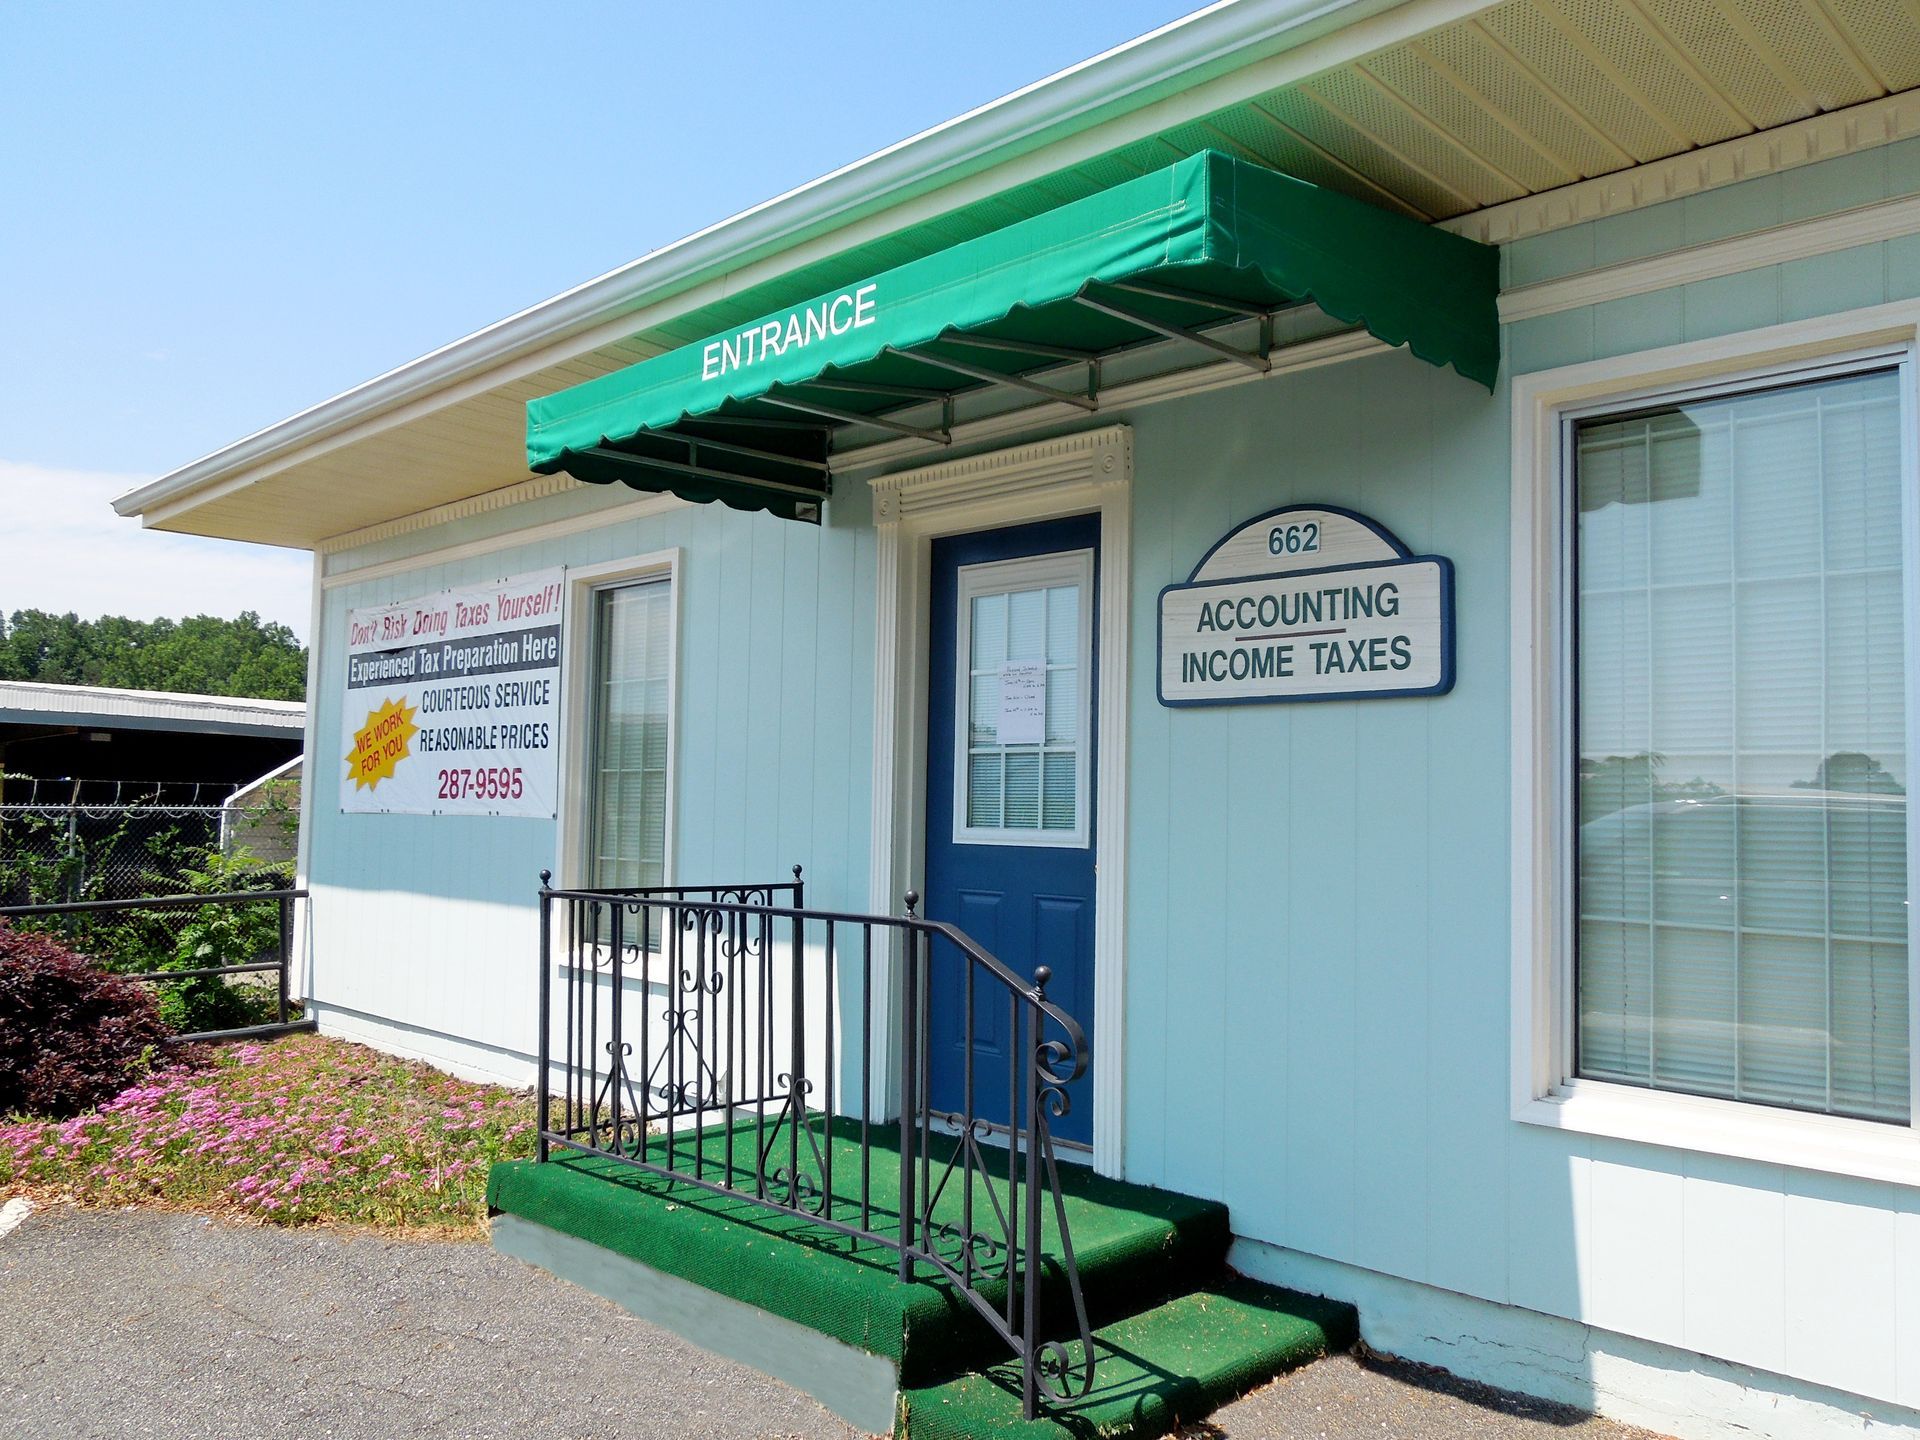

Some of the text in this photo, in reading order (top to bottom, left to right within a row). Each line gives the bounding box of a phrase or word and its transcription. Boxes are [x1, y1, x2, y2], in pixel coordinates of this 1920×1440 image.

[702, 283, 877, 382] ENTRANCE
[1268, 523, 1319, 555] 662
[350, 583, 561, 646] Don't Risk Doing Taxes Yourself!
[1196, 582, 1399, 633] ACCOUNTING
[350, 633, 557, 687] Experienced Tax Preparation Here
[1182, 635, 1412, 683] INCOME TAXES
[422, 679, 550, 714] COURTEOUS SERVICE
[356, 708, 404, 754] WE WORK
[420, 722, 549, 752] REASONABLE PRICES
[361, 734, 403, 776] FOR YOU
[438, 767, 523, 800] 287-9595
